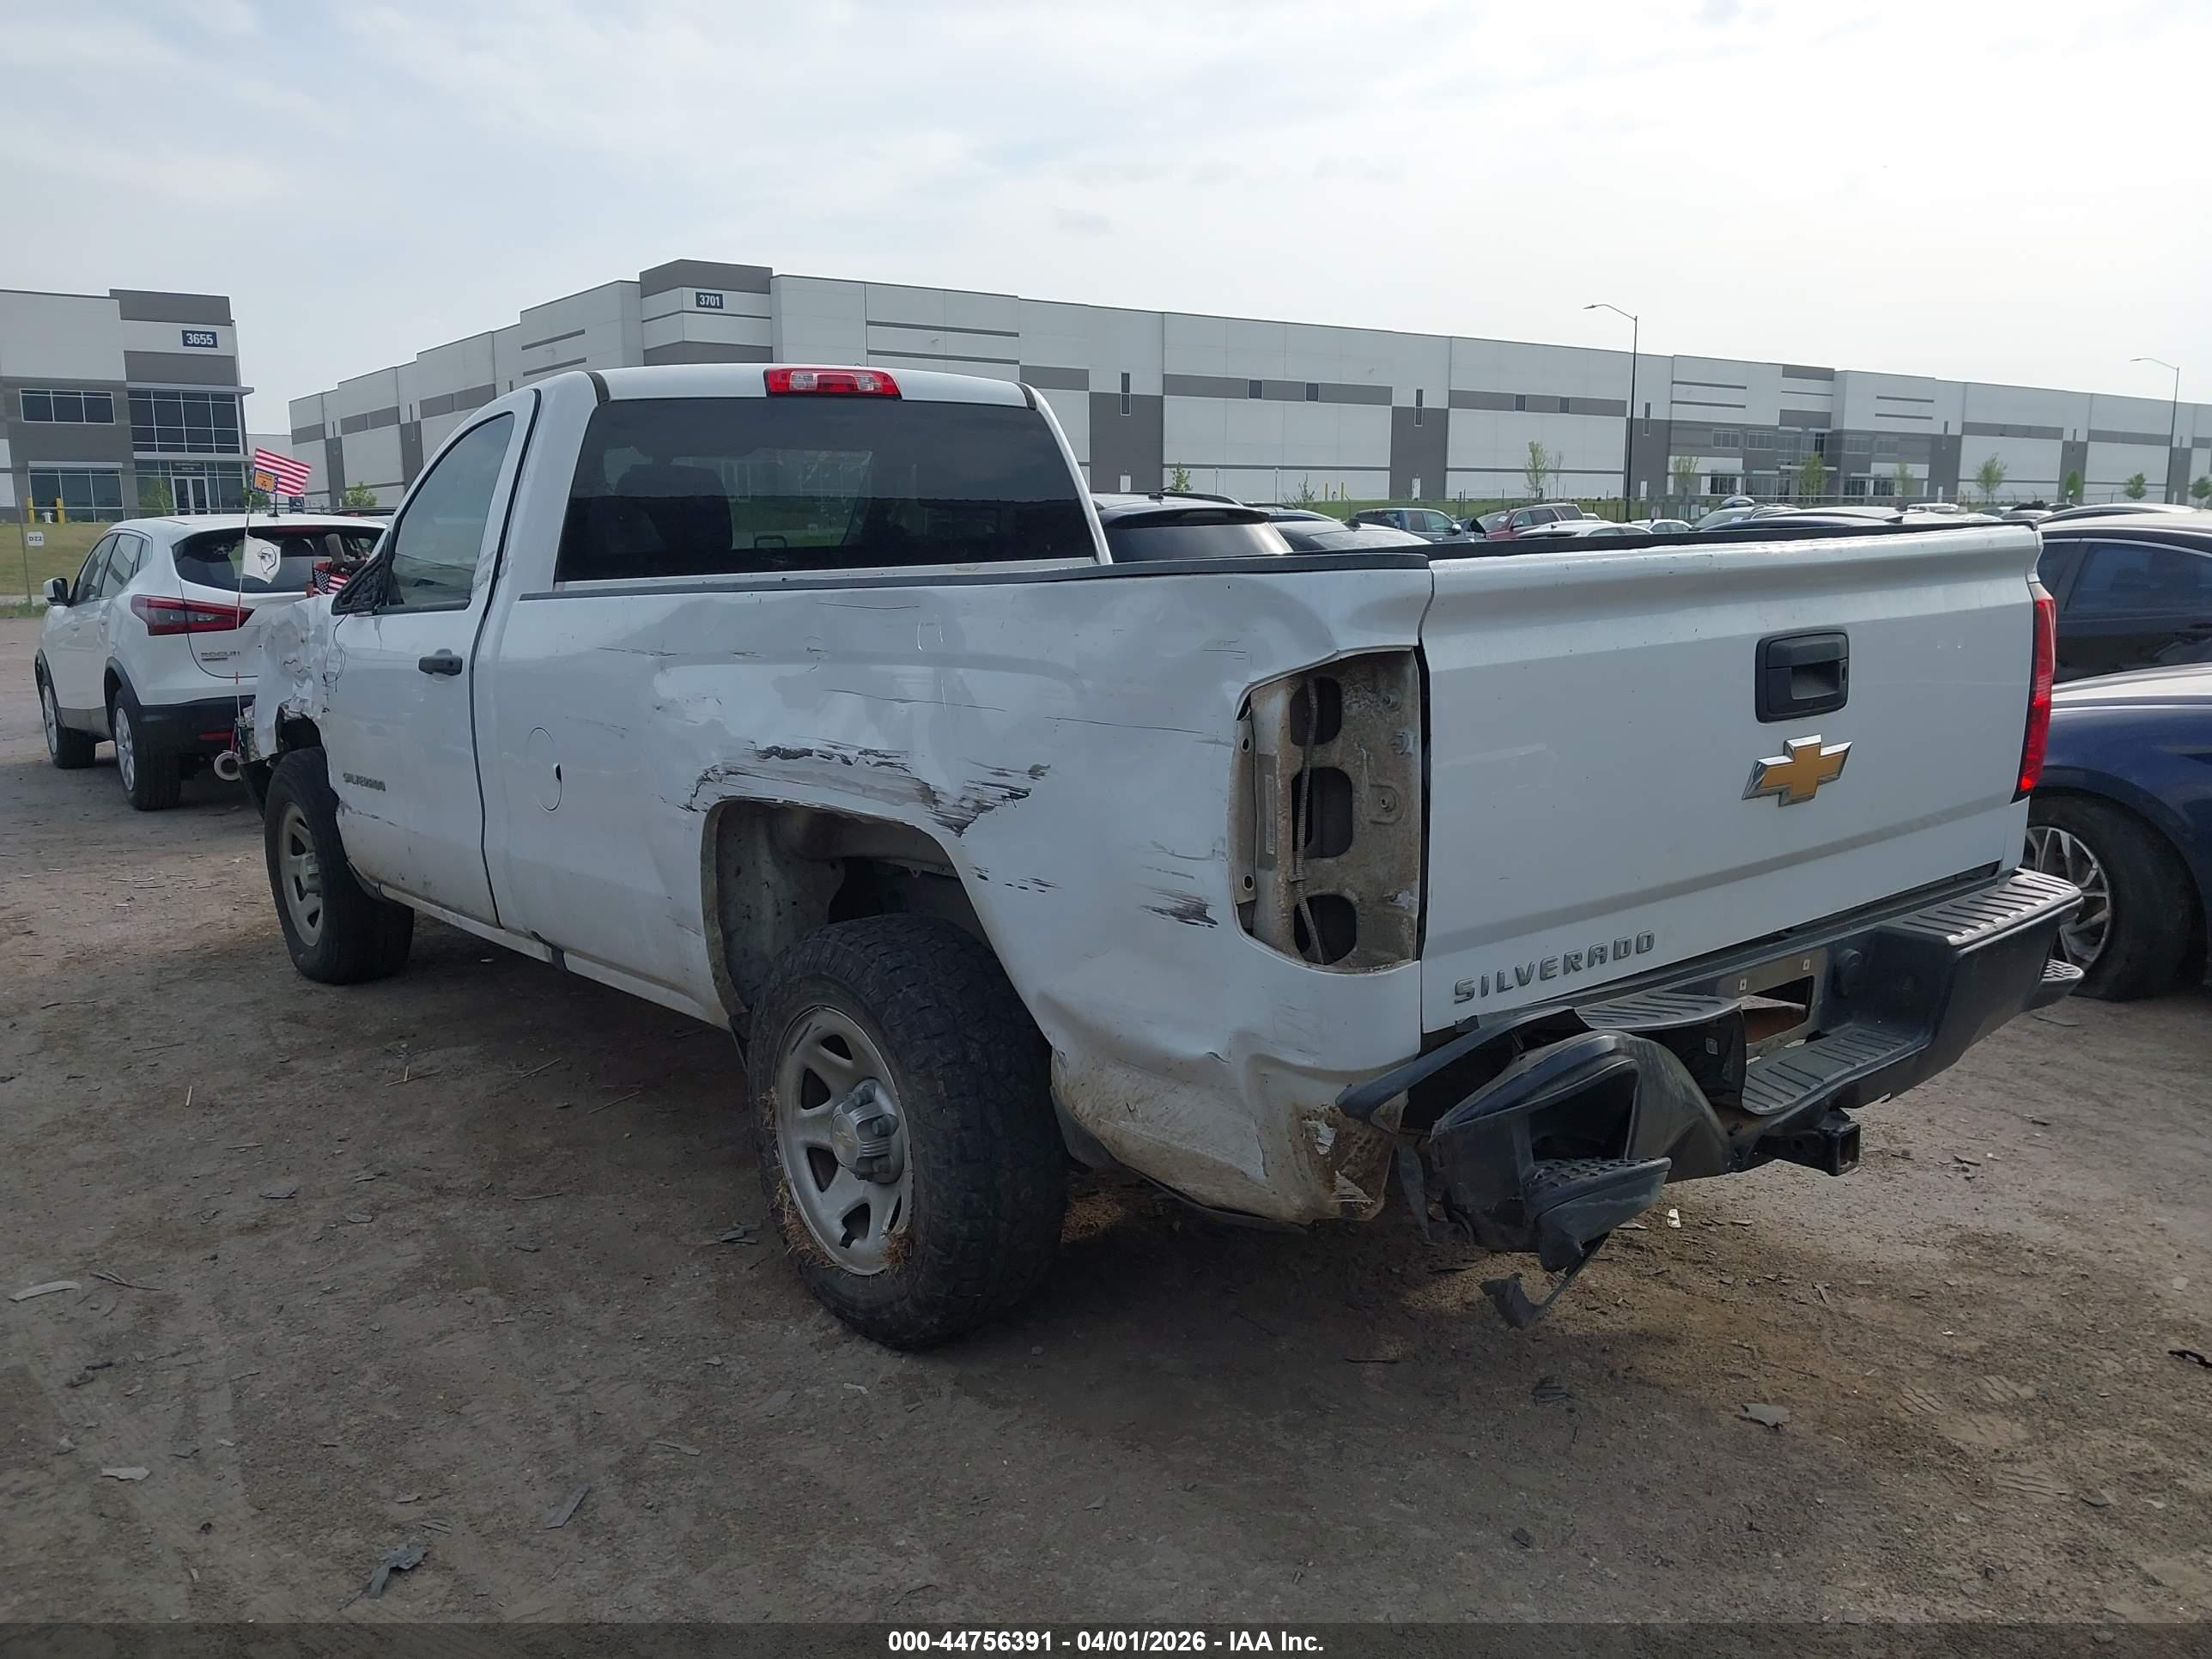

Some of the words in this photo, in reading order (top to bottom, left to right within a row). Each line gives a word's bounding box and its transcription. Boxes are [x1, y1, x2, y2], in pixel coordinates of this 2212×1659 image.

[699, 295, 720, 307] 3701
[185, 332, 214, 345] 3655
[1454, 929, 1656, 1004] SILVERADO
